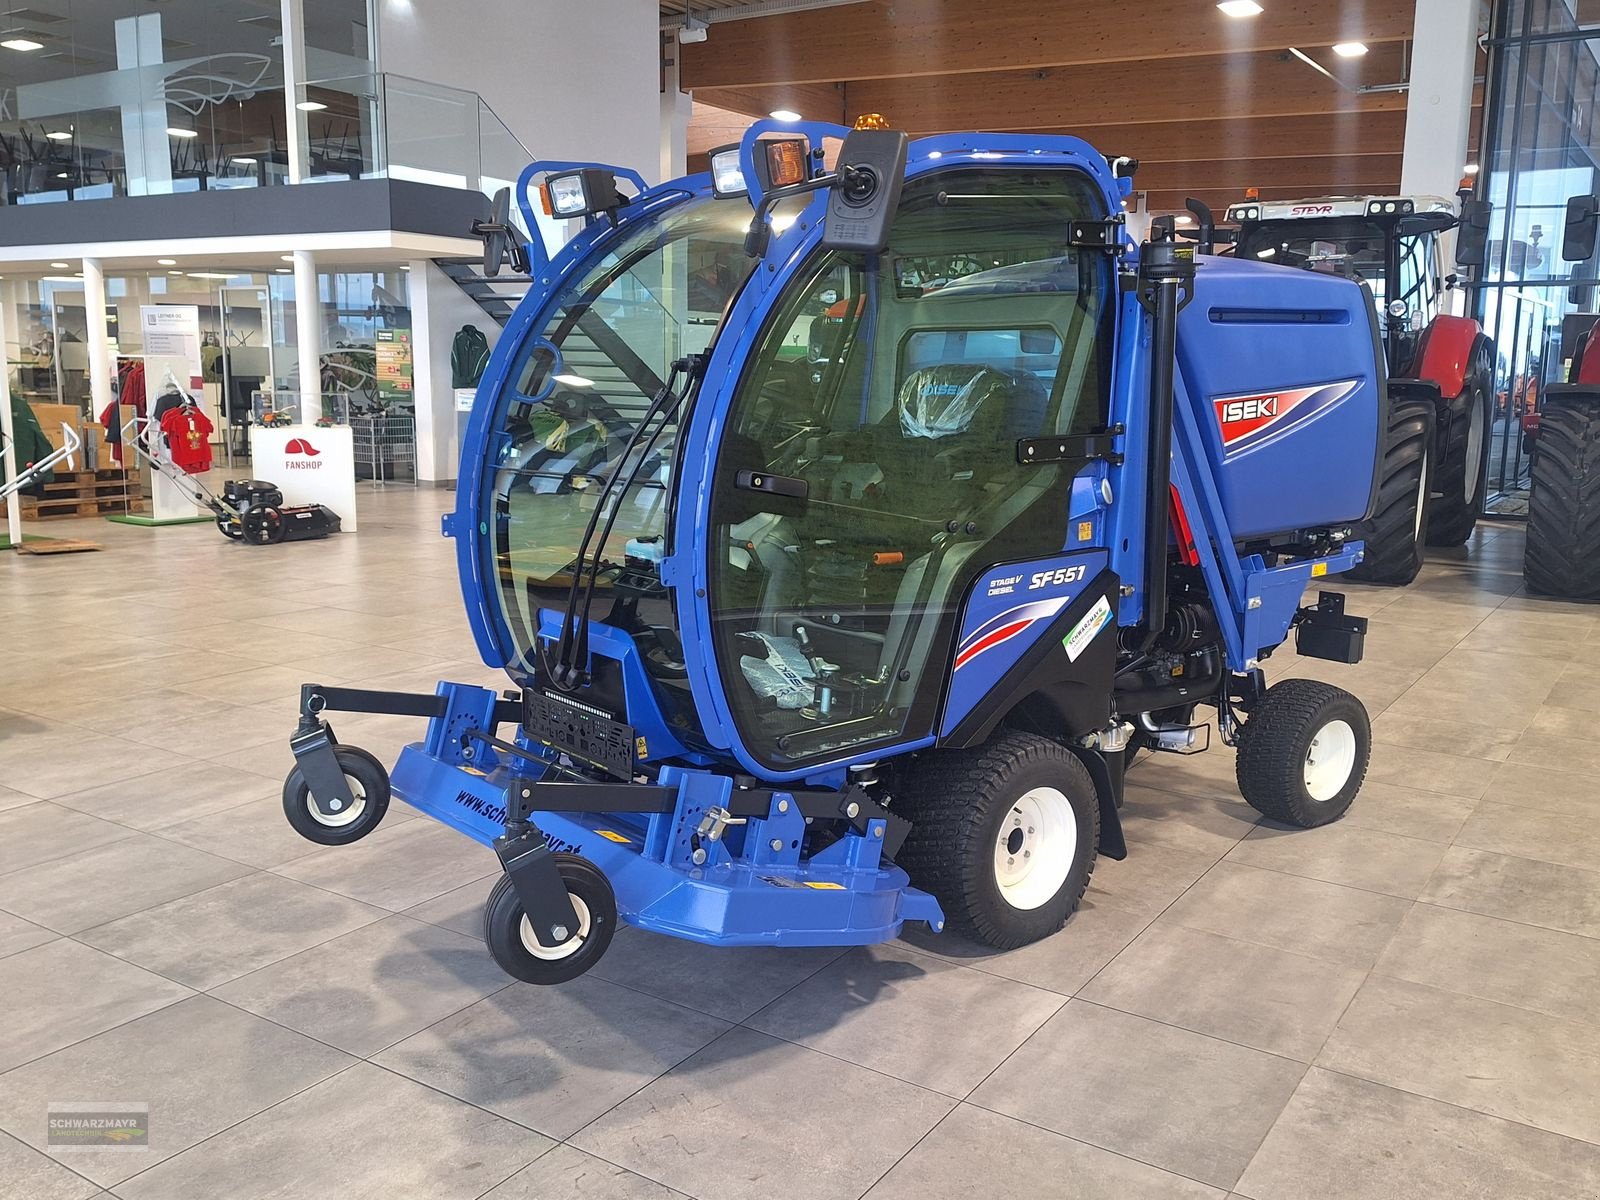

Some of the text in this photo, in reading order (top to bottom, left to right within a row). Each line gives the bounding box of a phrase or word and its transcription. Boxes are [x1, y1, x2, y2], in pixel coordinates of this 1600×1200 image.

[1291, 205, 1333, 216] STEYR
[1222, 396, 1279, 424] ISEKI
[285, 460, 322, 470] FANSHOP
[989, 578, 1016, 588] STAGE
[1028, 565, 1086, 590] SF551
[987, 586, 1015, 597] DIESEL
[1068, 607, 1103, 645] SCHWARZMAYR
